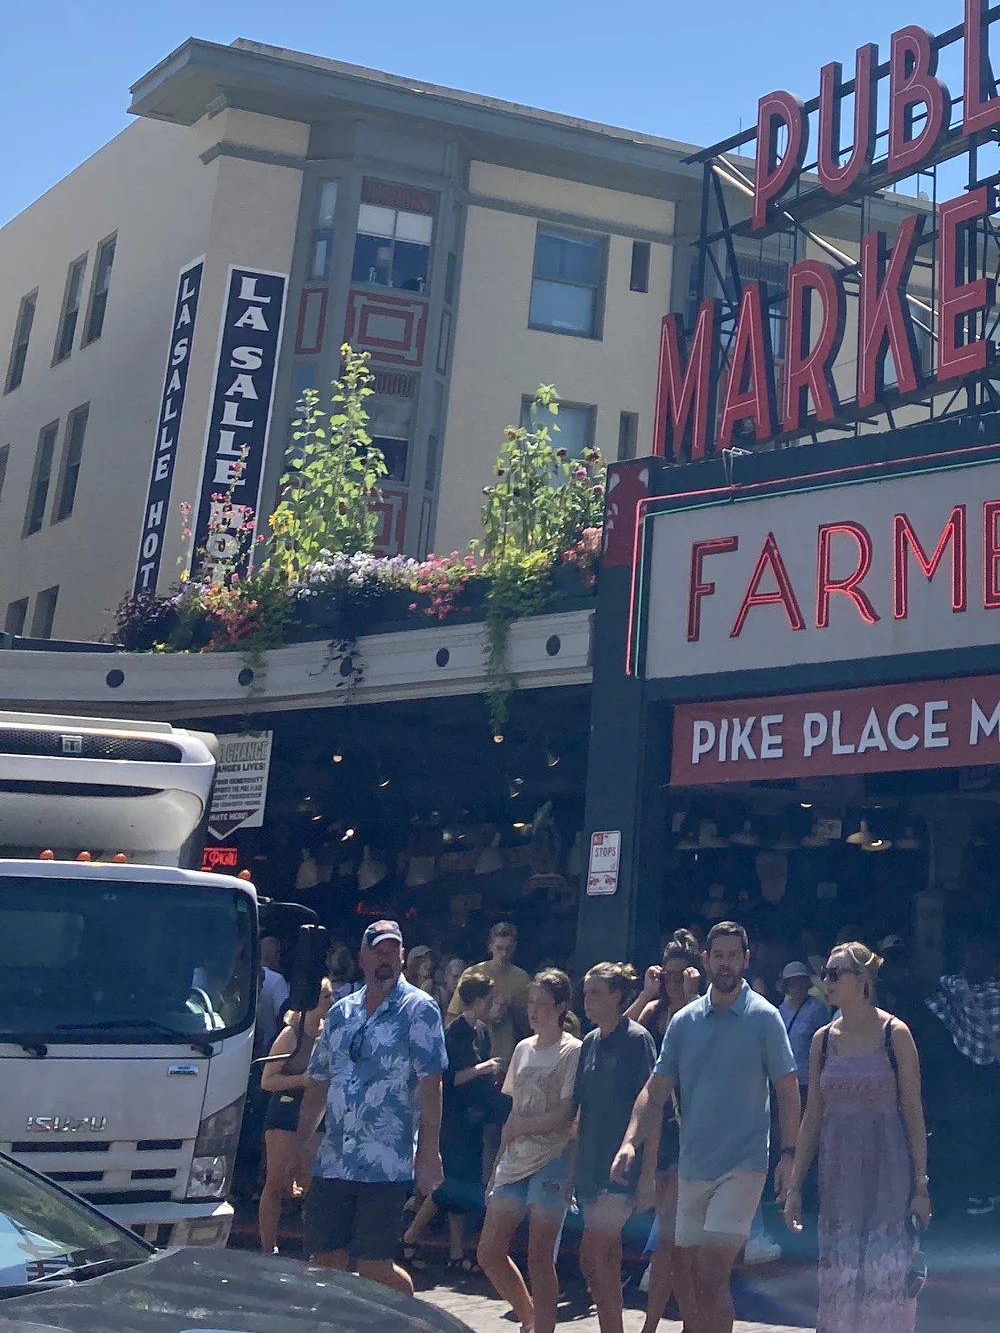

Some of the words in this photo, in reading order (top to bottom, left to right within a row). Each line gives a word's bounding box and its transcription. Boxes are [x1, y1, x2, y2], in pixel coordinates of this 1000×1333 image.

[175, 276, 196, 331] LA
[233, 276, 272, 332] LA
[154, 337, 189, 482] SALLE
[212, 345, 263, 486] SALLE
[137, 499, 164, 602] HOT
[200, 501, 247, 586] HOT
[692, 714, 784, 764] PIKE
[804, 700, 949, 757] PLACE
[594, 846, 617, 858] STOPS
[26, 1116, 108, 1133] ISUZU
